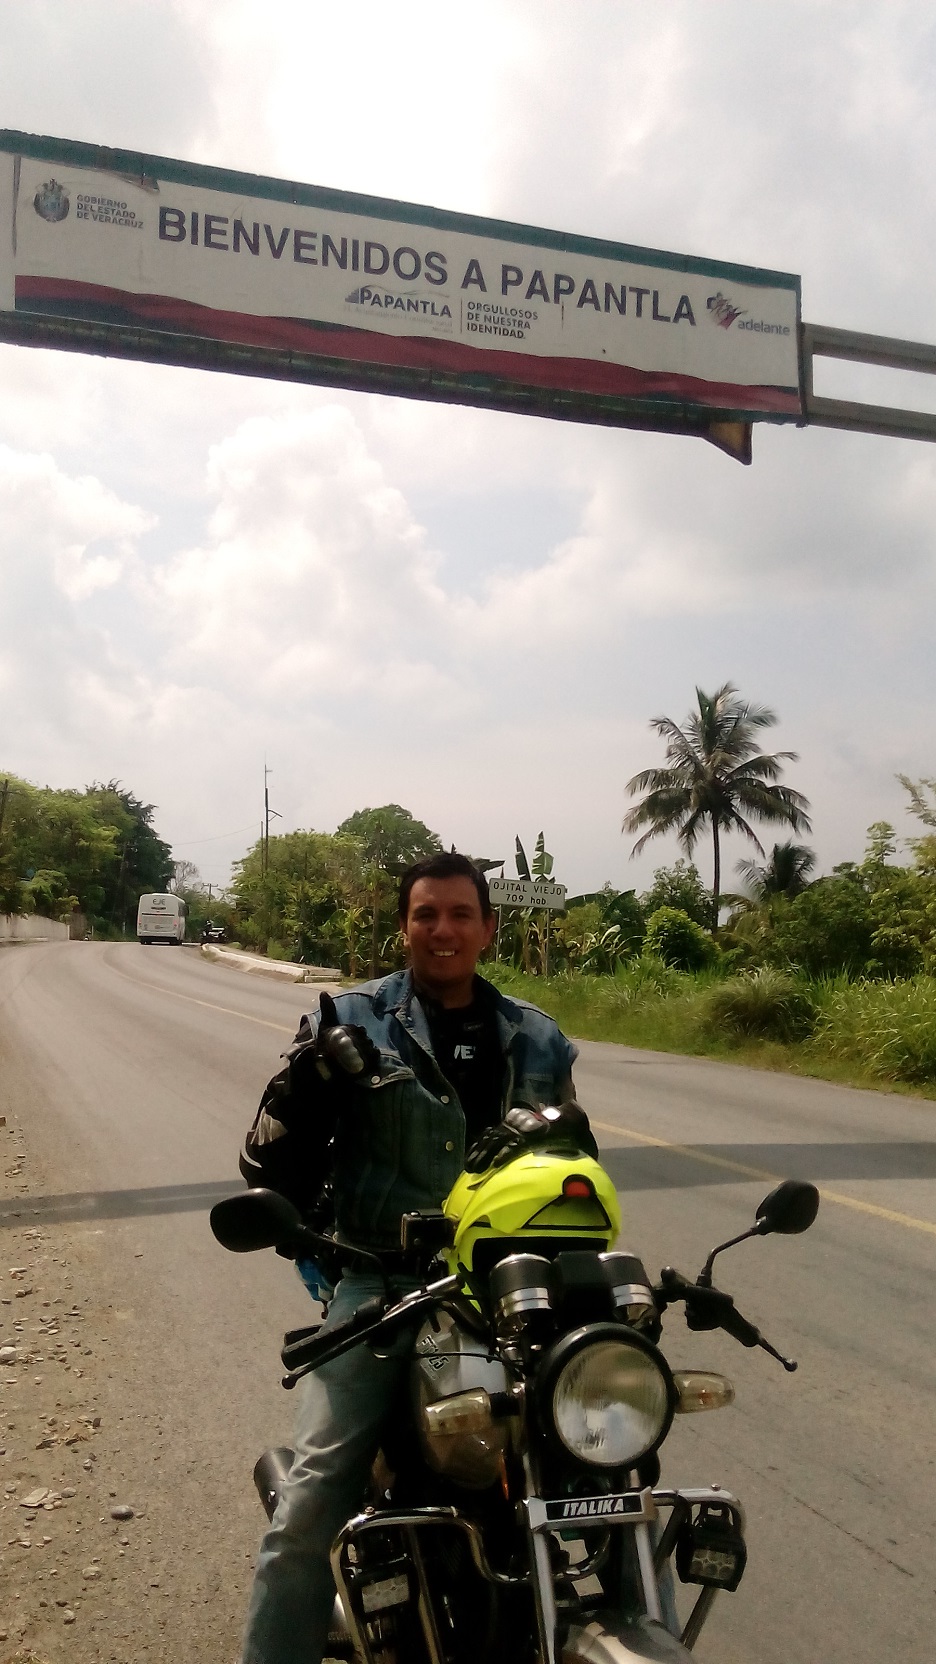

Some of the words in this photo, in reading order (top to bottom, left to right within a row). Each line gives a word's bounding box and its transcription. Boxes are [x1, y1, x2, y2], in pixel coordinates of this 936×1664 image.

[77, 194, 128, 210] GOBIERNO
[77, 202, 96, 213] DEL
[97, 206, 136, 220] ESTADO
[77, 211, 90, 220] DE
[92, 213, 145, 229] VERACRUZ
[158, 206, 449, 286] BIENVENIDOS
[460, 258, 488, 293] A
[501, 264, 697, 326] PAPANTLA
[360, 287, 453, 319] PAPANTLA
[467, 301, 539, 320] ORGULLOSOS
[467, 311, 481, 322] DE
[483, 314, 531, 330] NUESTRA
[737, 318, 791, 336] adelante
[493, 881, 528, 893] OJITAL
[533, 885, 562, 896] VIEJO
[505, 893, 524, 903] 709
[562, 1498, 625, 1517] ITALIKA
